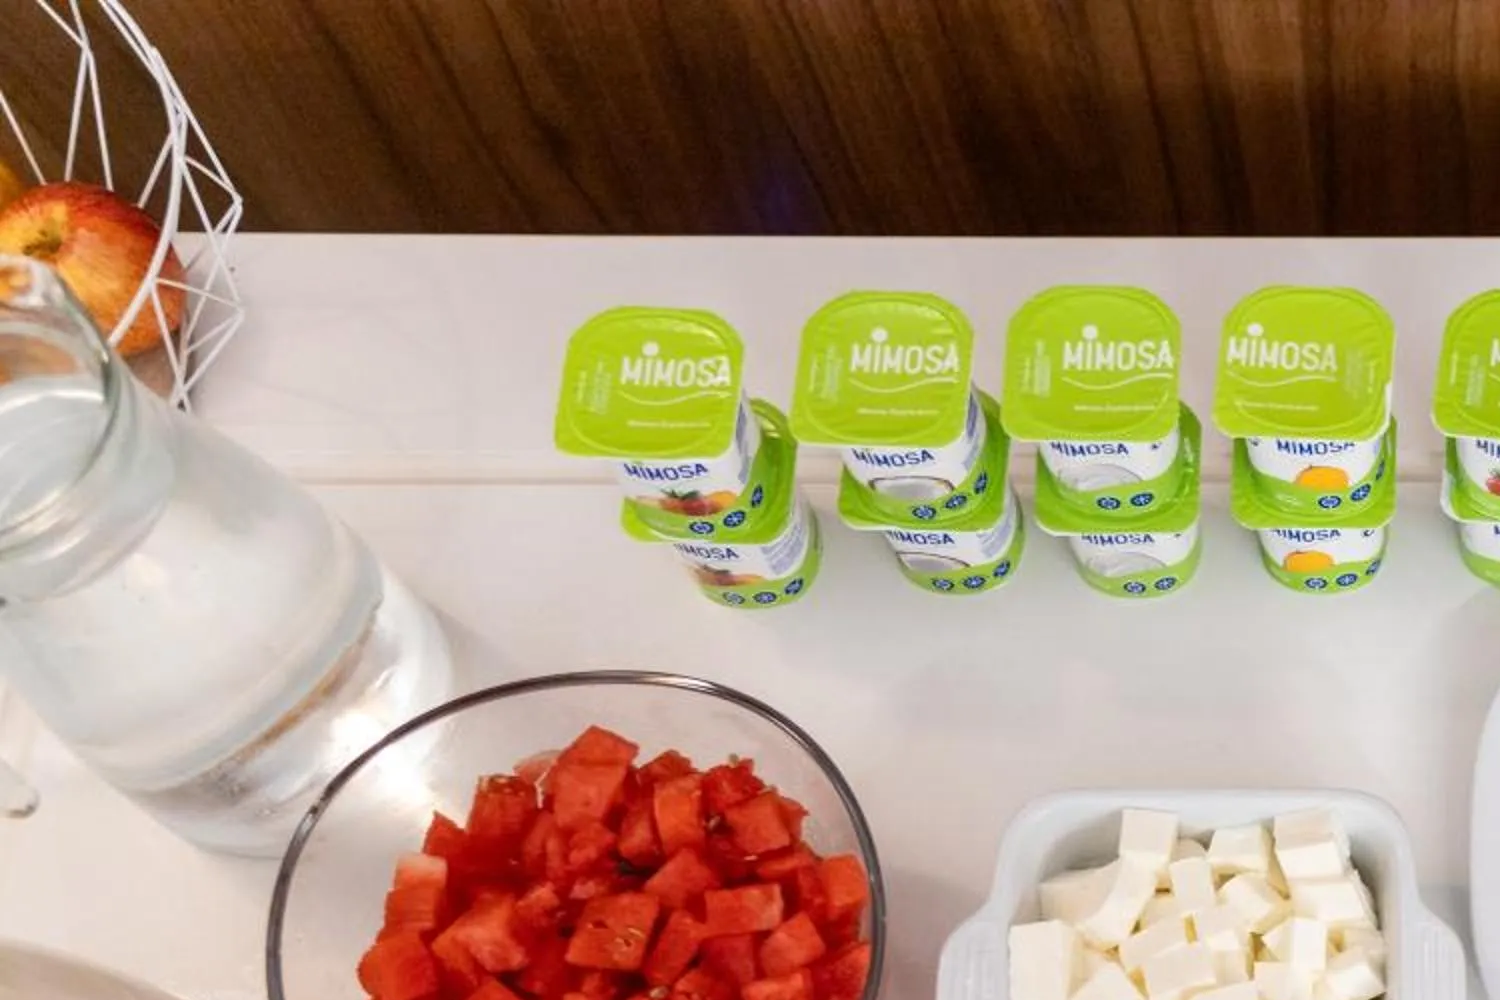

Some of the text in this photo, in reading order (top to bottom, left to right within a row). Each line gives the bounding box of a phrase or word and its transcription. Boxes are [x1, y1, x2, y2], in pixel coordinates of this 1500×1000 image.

[849, 327, 960, 374] MIMOSA
[1061, 324, 1174, 371] MIMOSA
[1226, 323, 1338, 372] MIMOSA
[620, 341, 732, 388] MIMOSA
[852, 448, 935, 467] MIMOSA
[1051, 441, 1129, 457] MIMOSA
[624, 463, 708, 481] MIMOSA
[674, 543, 739, 560] MOSA
